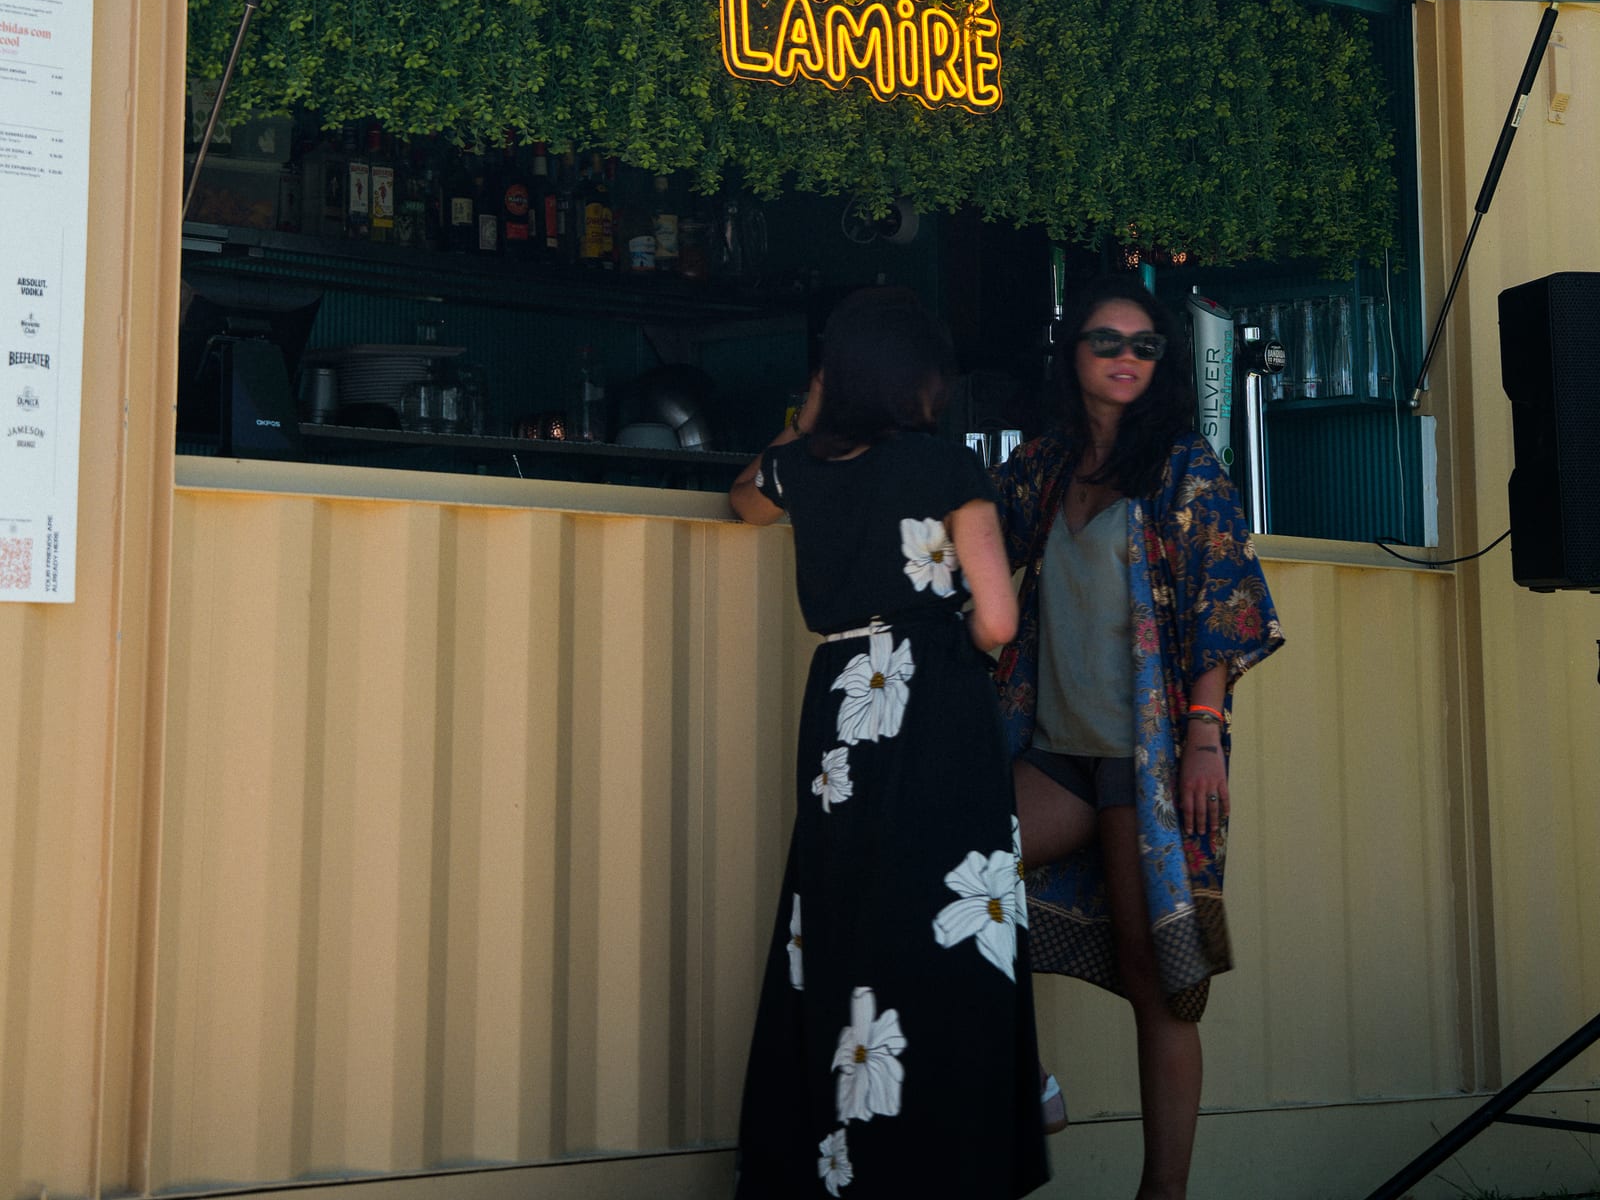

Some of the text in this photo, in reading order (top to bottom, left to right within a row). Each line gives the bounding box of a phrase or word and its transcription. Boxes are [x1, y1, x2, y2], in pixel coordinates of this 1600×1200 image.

[31, 29, 52, 40] com
[21, 287, 44, 297] VODKA
[9, 351, 50, 370] BEEFEATER
[1220, 329, 1233, 418] Heineken
[1203, 348, 1220, 437] SILVER
[7, 425, 45, 438] JAMESON
